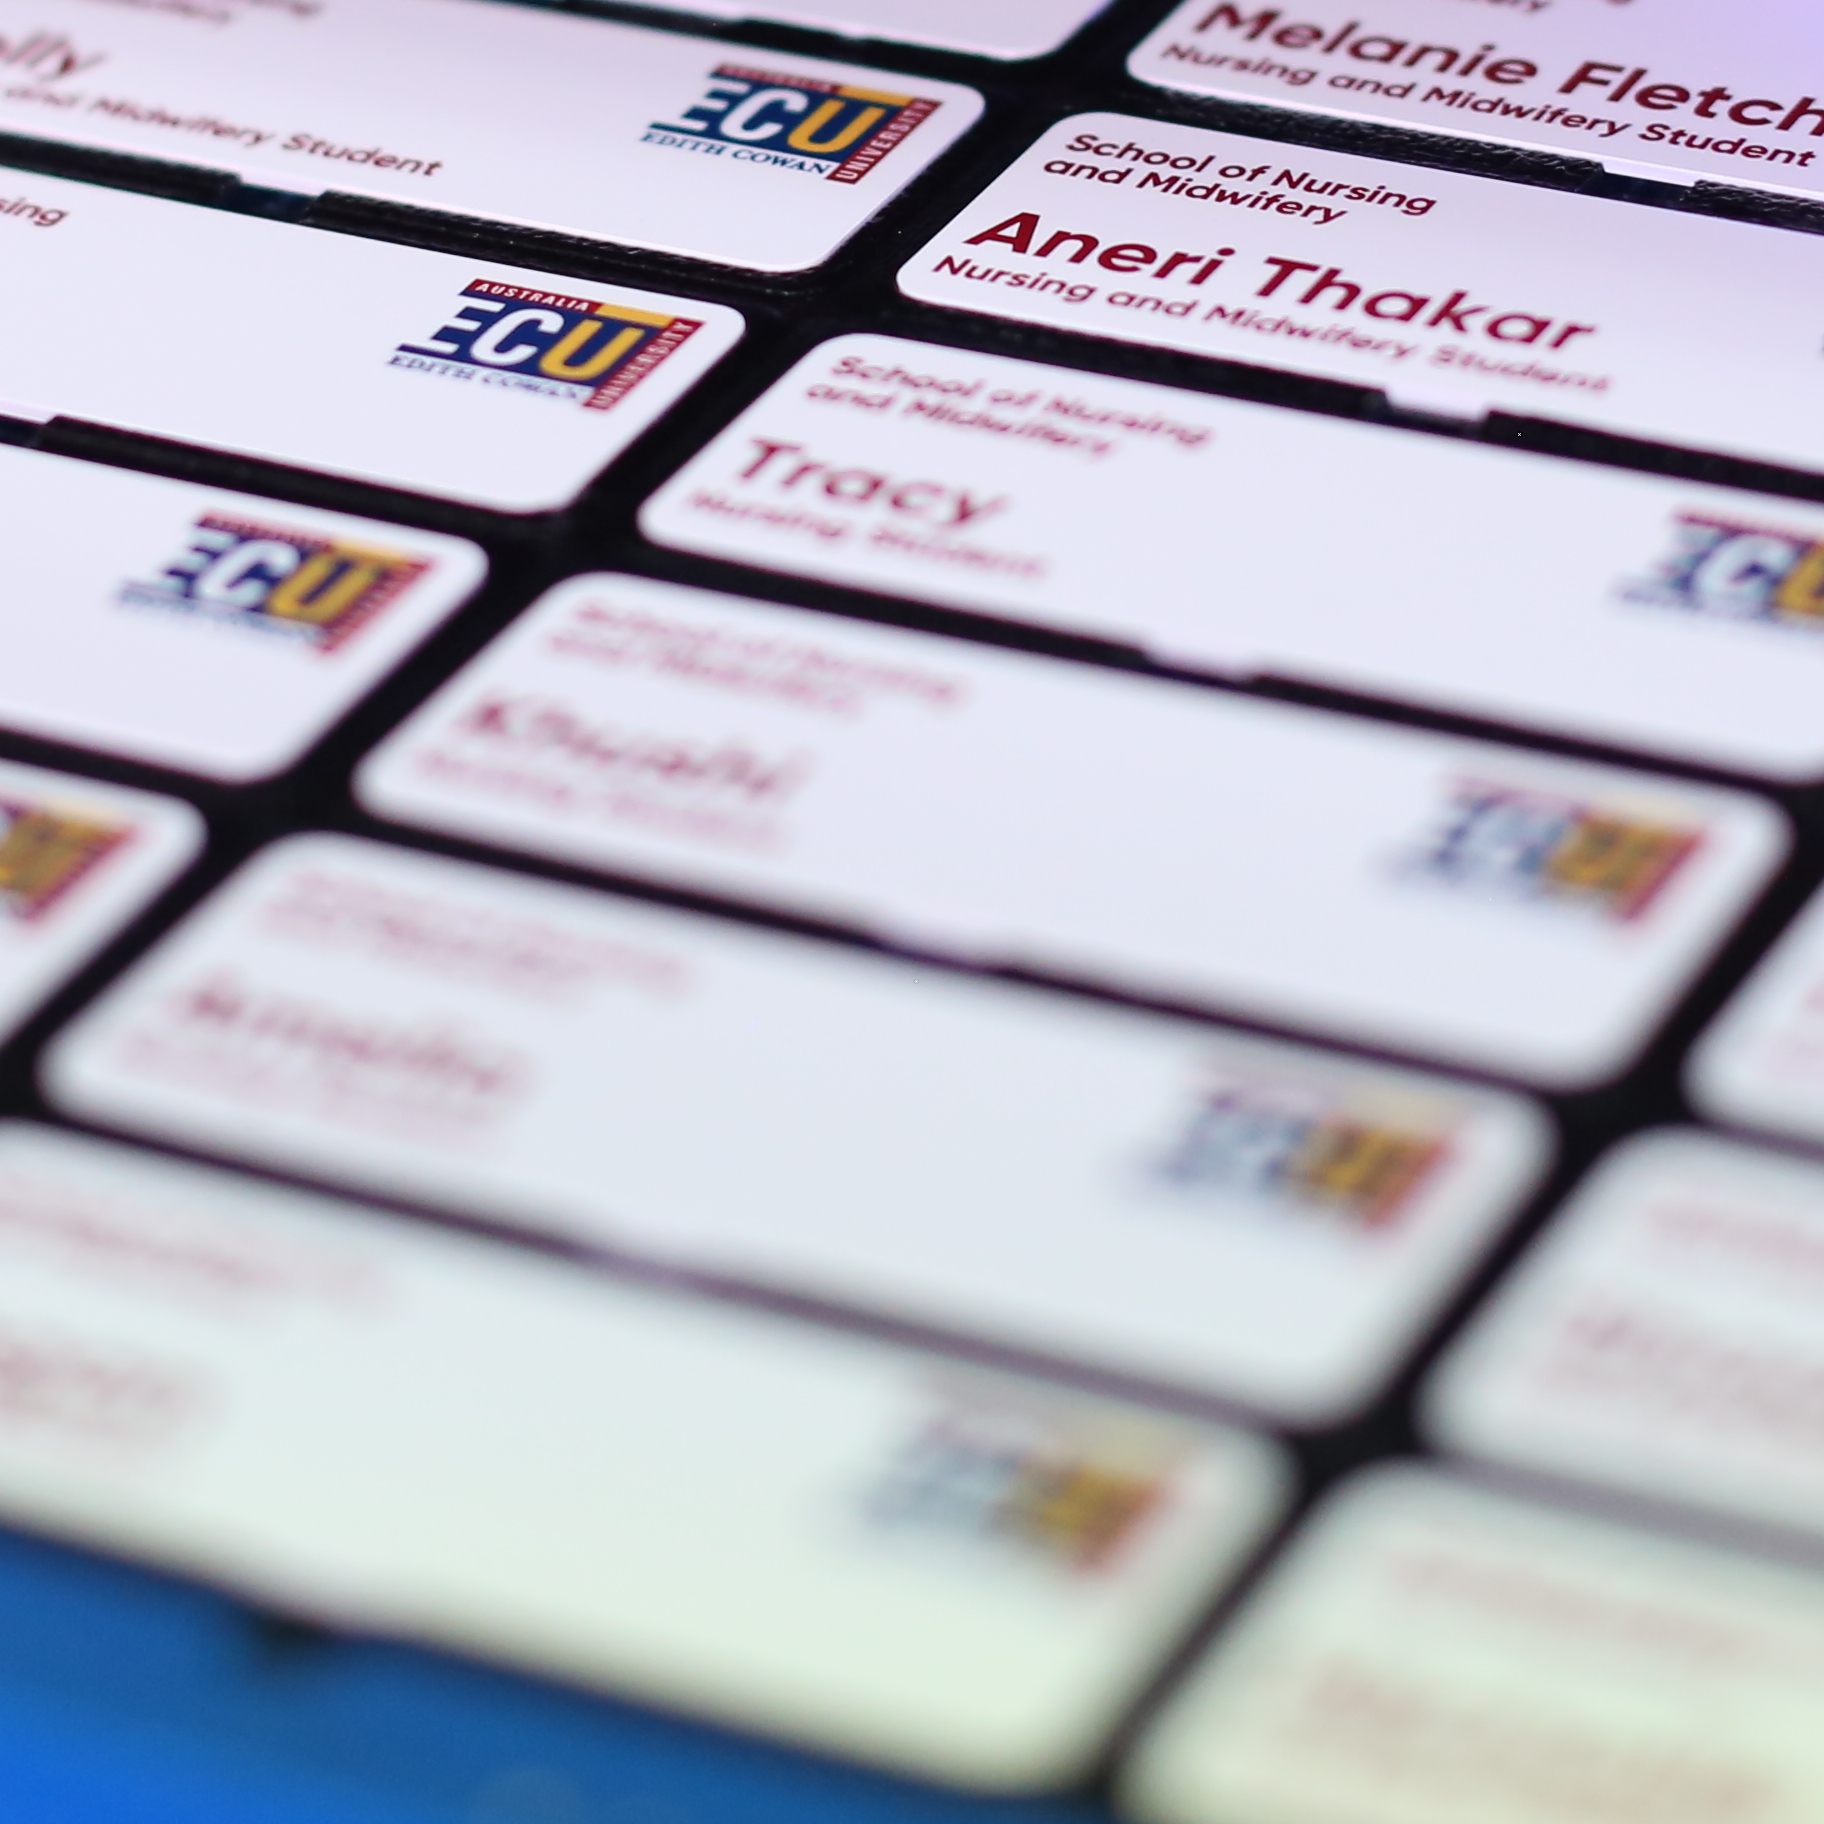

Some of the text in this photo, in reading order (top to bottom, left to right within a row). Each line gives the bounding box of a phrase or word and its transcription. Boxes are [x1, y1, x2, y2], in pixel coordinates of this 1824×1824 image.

[1192, 0, 1542, 87] Melanie
[89, 96, 270, 150] Midwifery
[279, 131, 445, 180] Student
[672, 83, 887, 155] ECU
[836, 98, 939, 182] UNIVERSITY
[1159, 42, 1818, 171] Nursing and Midwifery Student
[639, 131, 832, 176] EDITH COWAN
[1042, 154, 1348, 226] and Midwifery
[1063, 132, 1438, 217] School of Nursing
[473, 282, 591, 312] AUSTRALIA
[932, 254, 1098, 304] Nursing
[1106, 284, 1196, 317] and
[1202, 302, 1417, 363] Midwifery
[962, 210, 1599, 352] Aneri Thakar
[386, 352, 476, 381] EDITH
[423, 300, 645, 381] ECU
[738, 436, 1014, 531] Tracy
[158, 530, 381, 626] ECU
